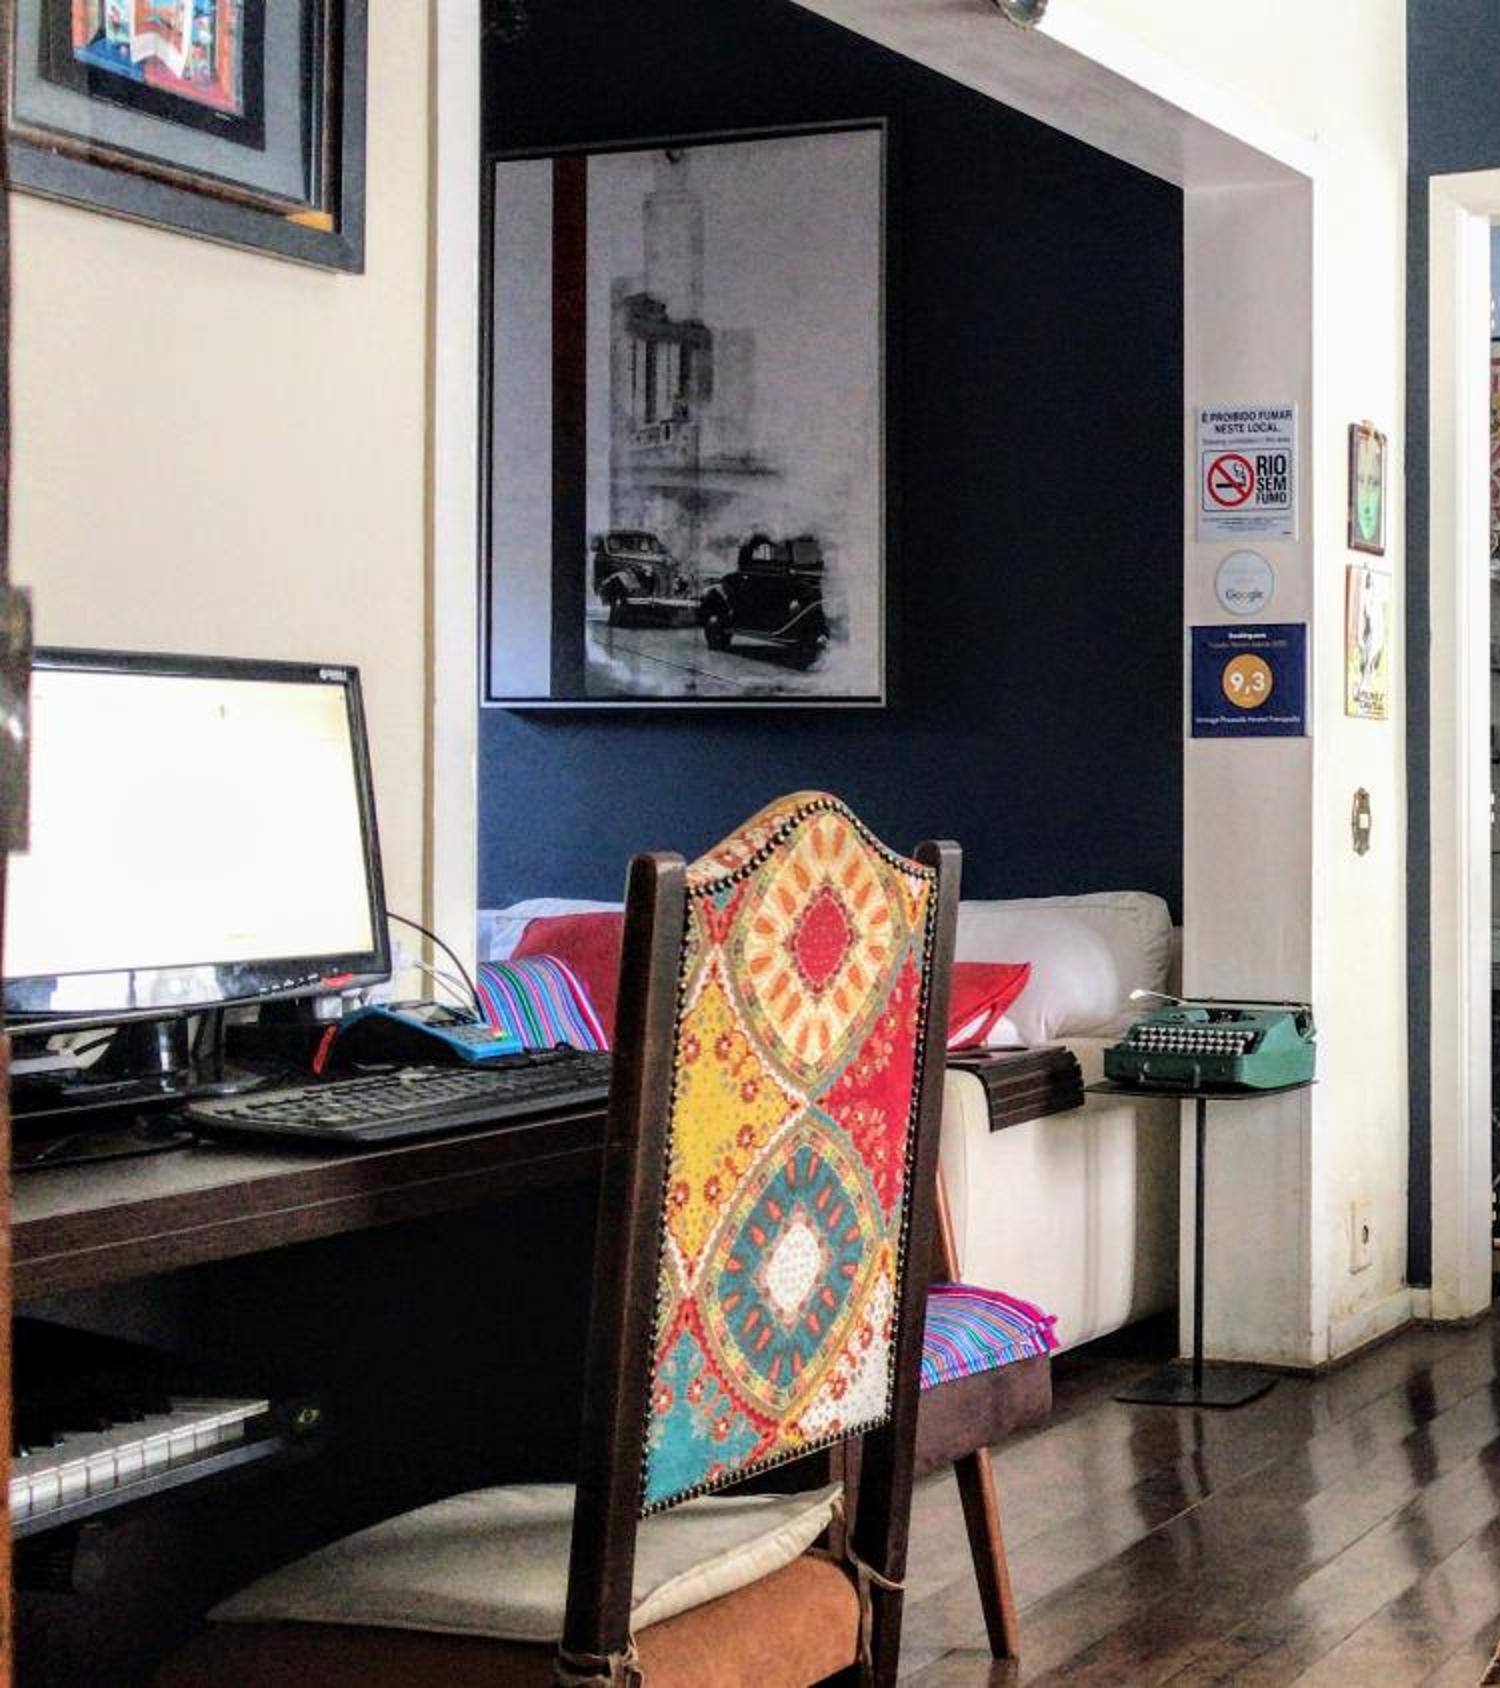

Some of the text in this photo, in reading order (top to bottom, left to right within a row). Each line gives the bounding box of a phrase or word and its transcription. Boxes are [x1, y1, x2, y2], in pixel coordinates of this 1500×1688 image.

[1210, 410, 1257, 422] PROIBIDO
[1258, 409, 1293, 420] FUMAR
[1215, 422, 1246, 434] NESTE
[1256, 453, 1287, 476] RIO
[1256, 476, 1287, 491] SEM
[1256, 492, 1287, 505] FUMO
[1230, 671, 1266, 695] 9,3
